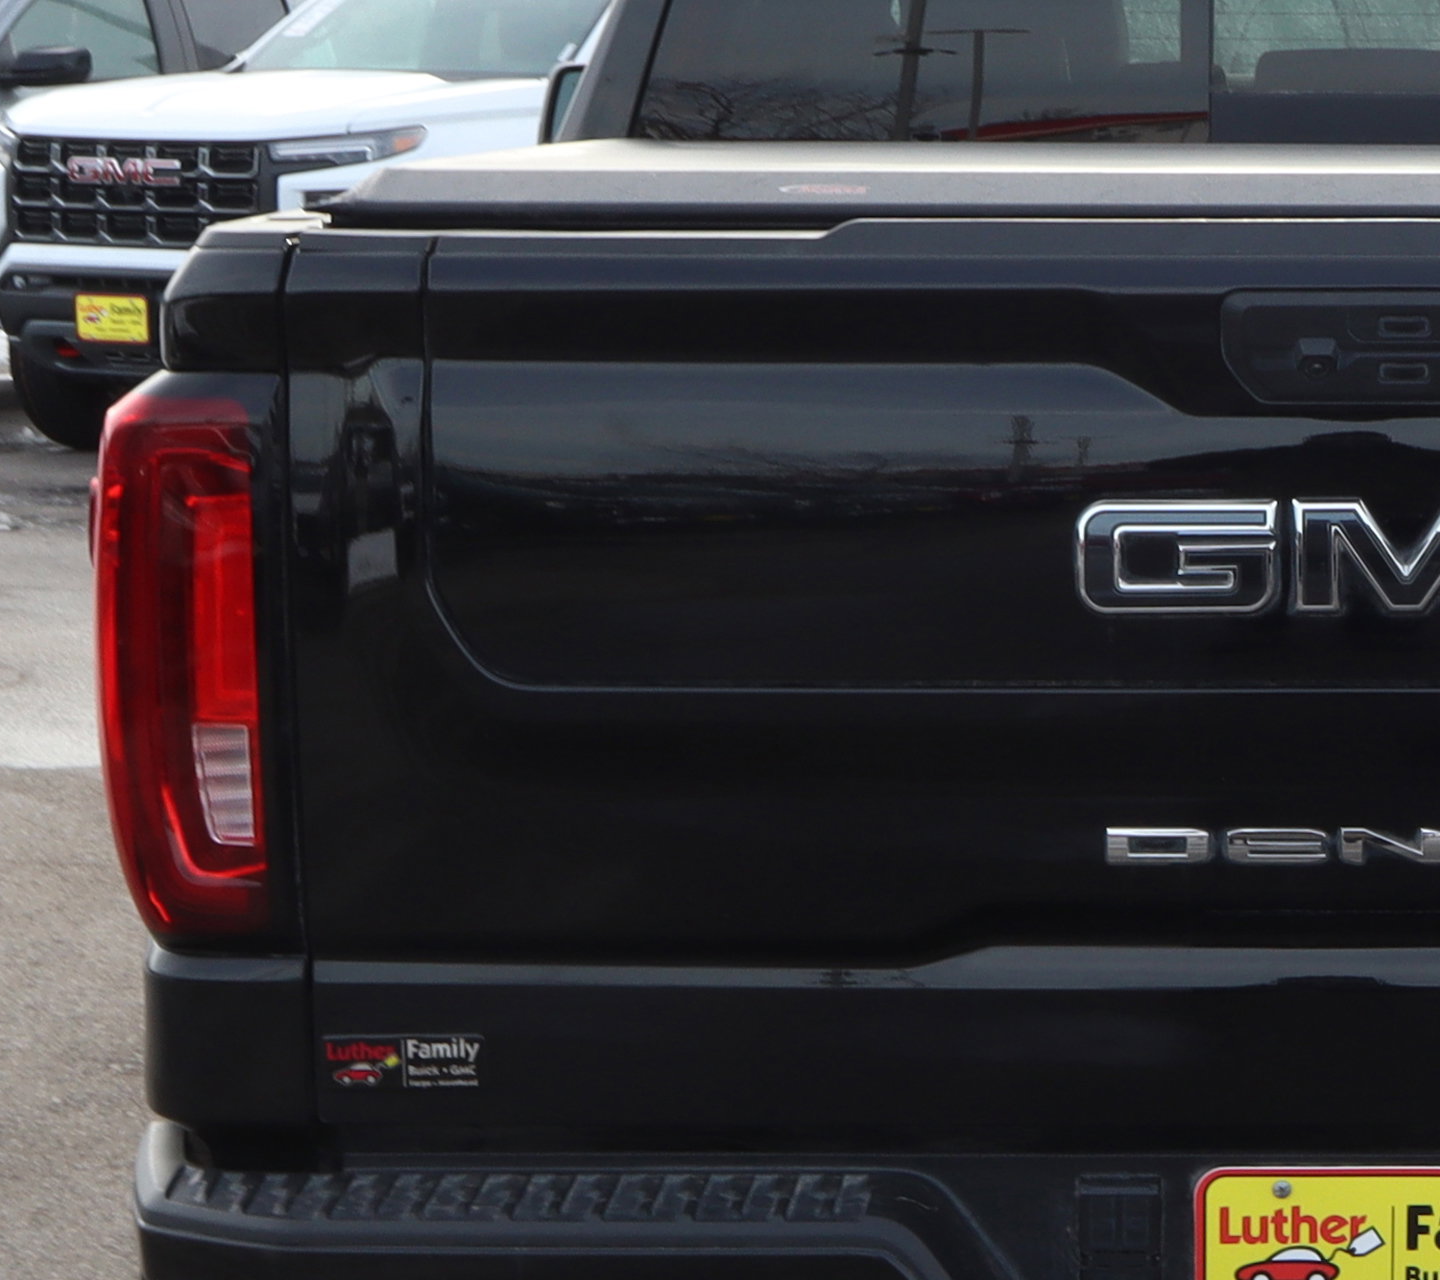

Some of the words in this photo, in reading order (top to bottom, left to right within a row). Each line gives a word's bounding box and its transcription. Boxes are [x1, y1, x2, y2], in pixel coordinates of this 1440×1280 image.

[67, 156, 181, 186] GMC
[325, 1041, 396, 1061] Luther
[407, 1037, 480, 1062] Family
[1219, 1205, 1368, 1245] Luther
